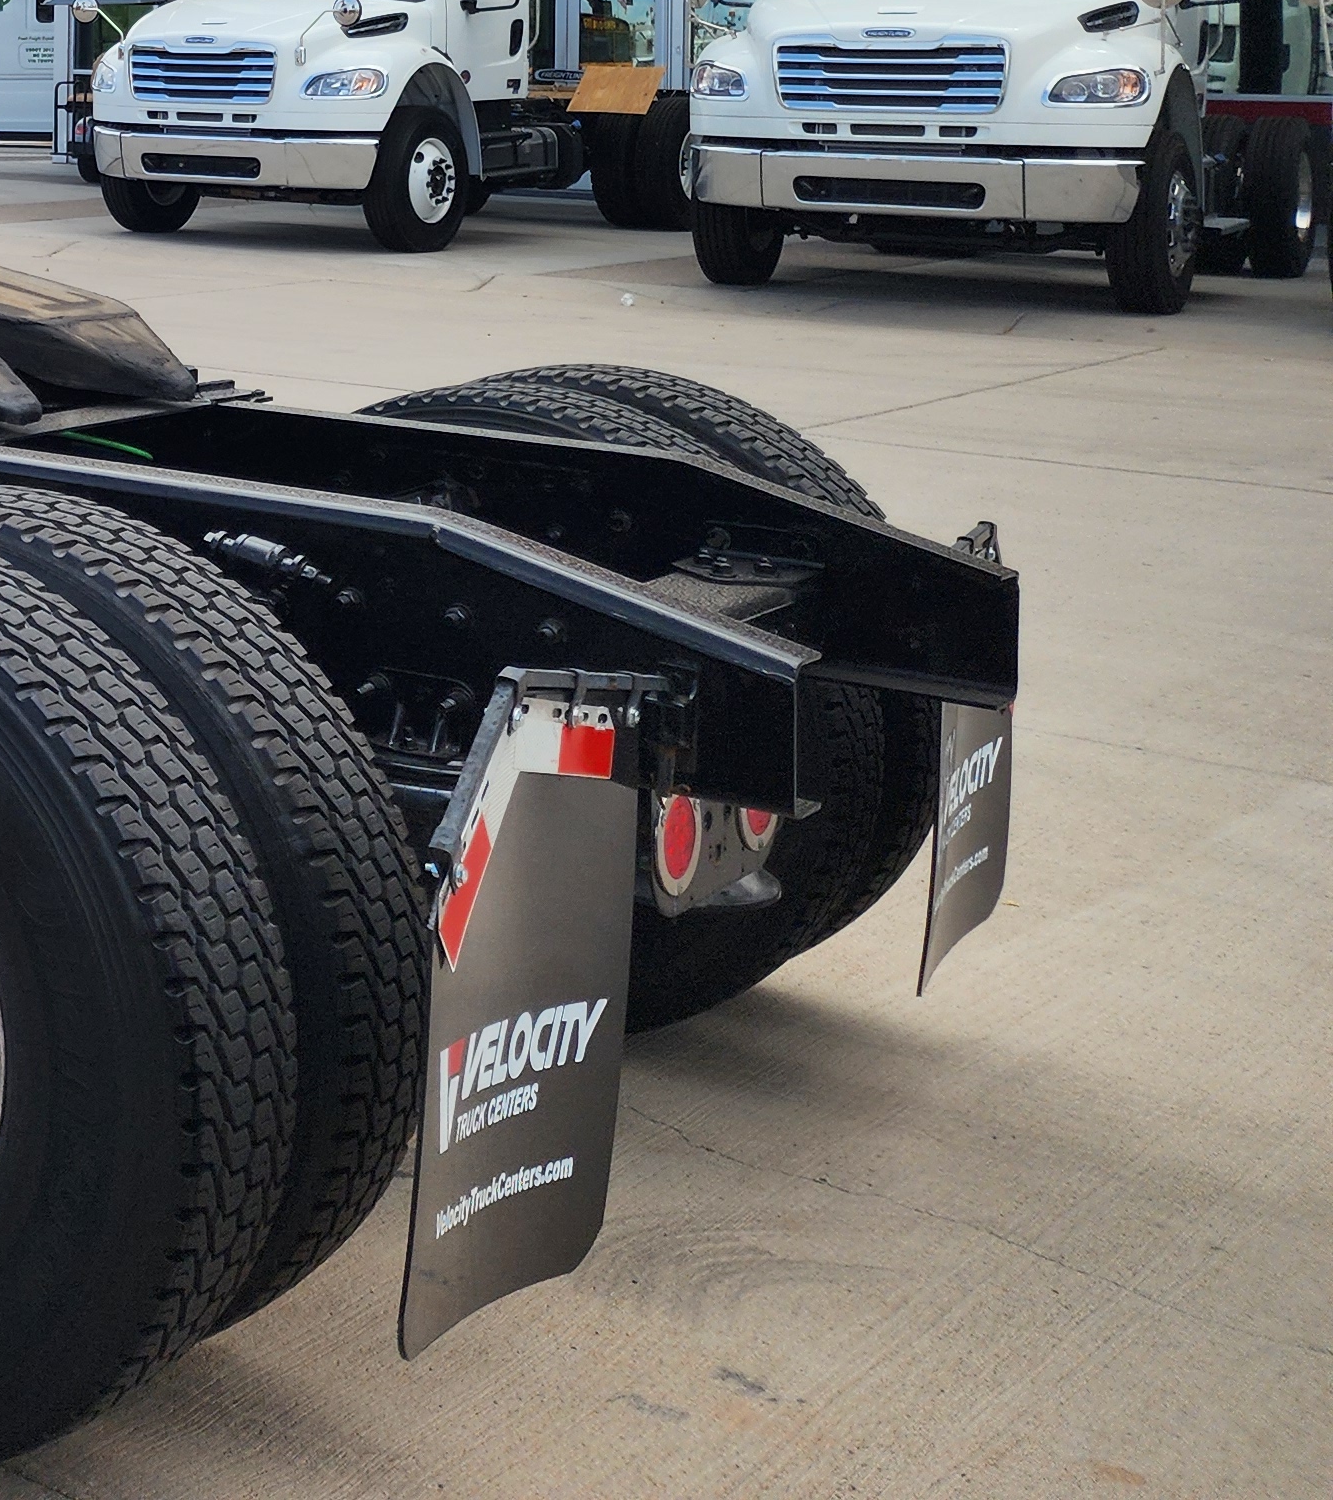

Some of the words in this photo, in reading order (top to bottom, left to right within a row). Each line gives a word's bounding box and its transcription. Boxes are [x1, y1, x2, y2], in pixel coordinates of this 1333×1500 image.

[540, 71, 583, 79] FREIGHTLIN
[461, 998, 608, 1100] VELOCITY
[455, 1102, 487, 1143] TRUCK
[486, 1082, 539, 1126] CENTERS
[435, 1156, 574, 1240] VelocityTruckCenters.com
